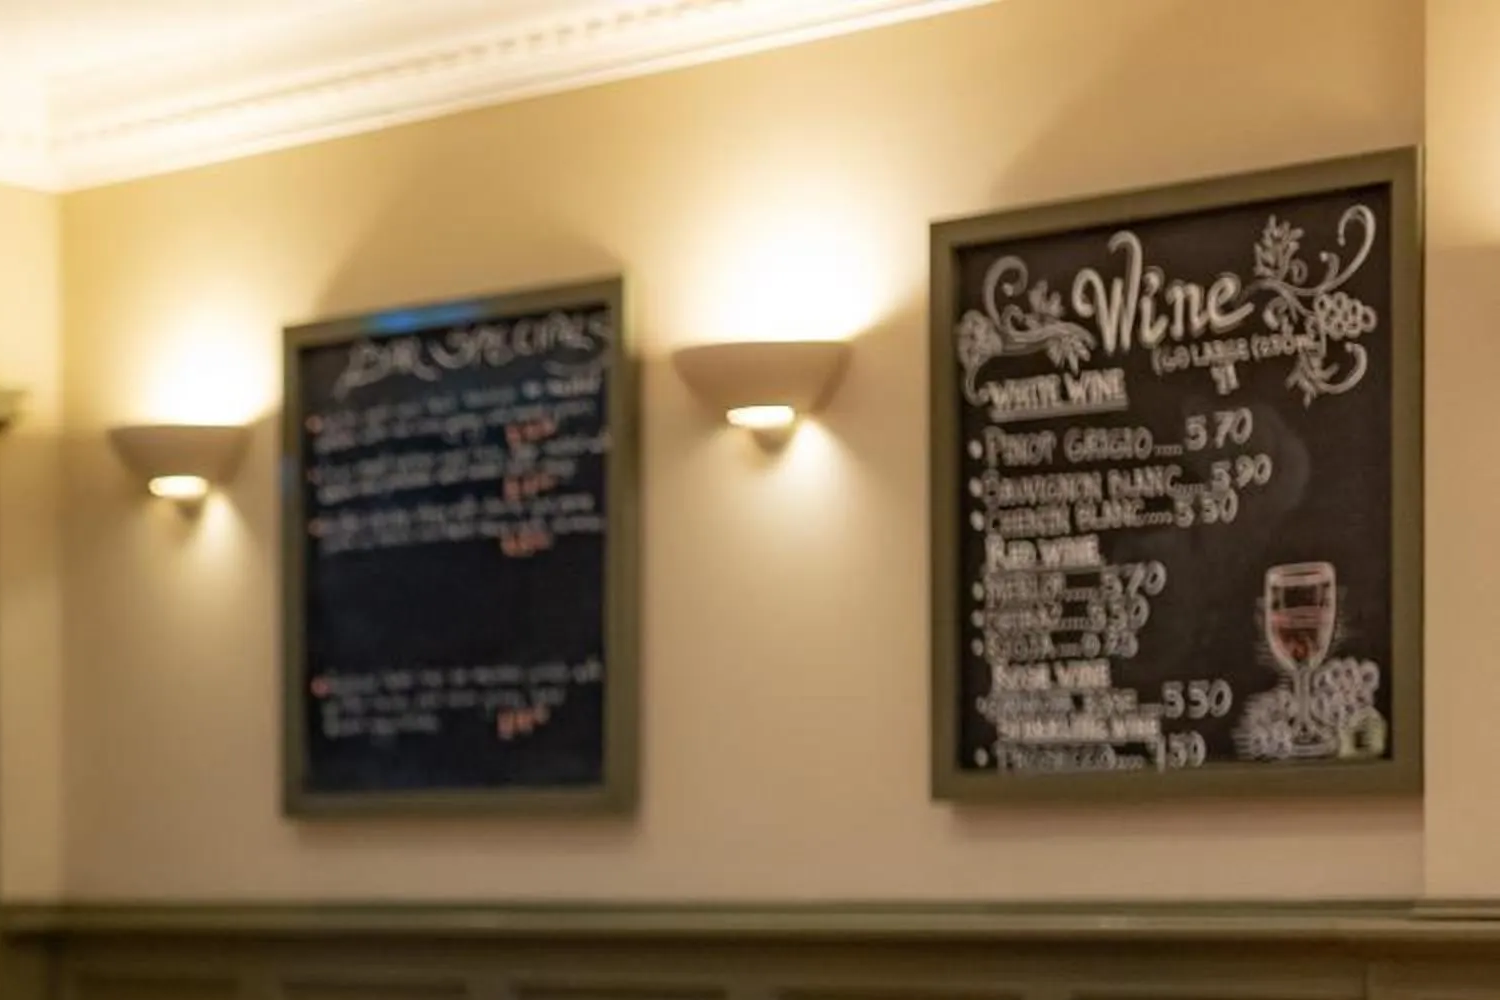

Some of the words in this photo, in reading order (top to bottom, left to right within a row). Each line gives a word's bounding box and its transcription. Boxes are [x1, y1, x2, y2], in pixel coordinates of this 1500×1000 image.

[1072, 230, 1255, 354] Wine
[986, 373, 1058, 412] WHITE
[1063, 368, 1127, 403] WINE
[983, 426, 1057, 467] PINOT
[1063, 427, 1153, 463] GRIGIO
[1107, 464, 1182, 500] BLANC
